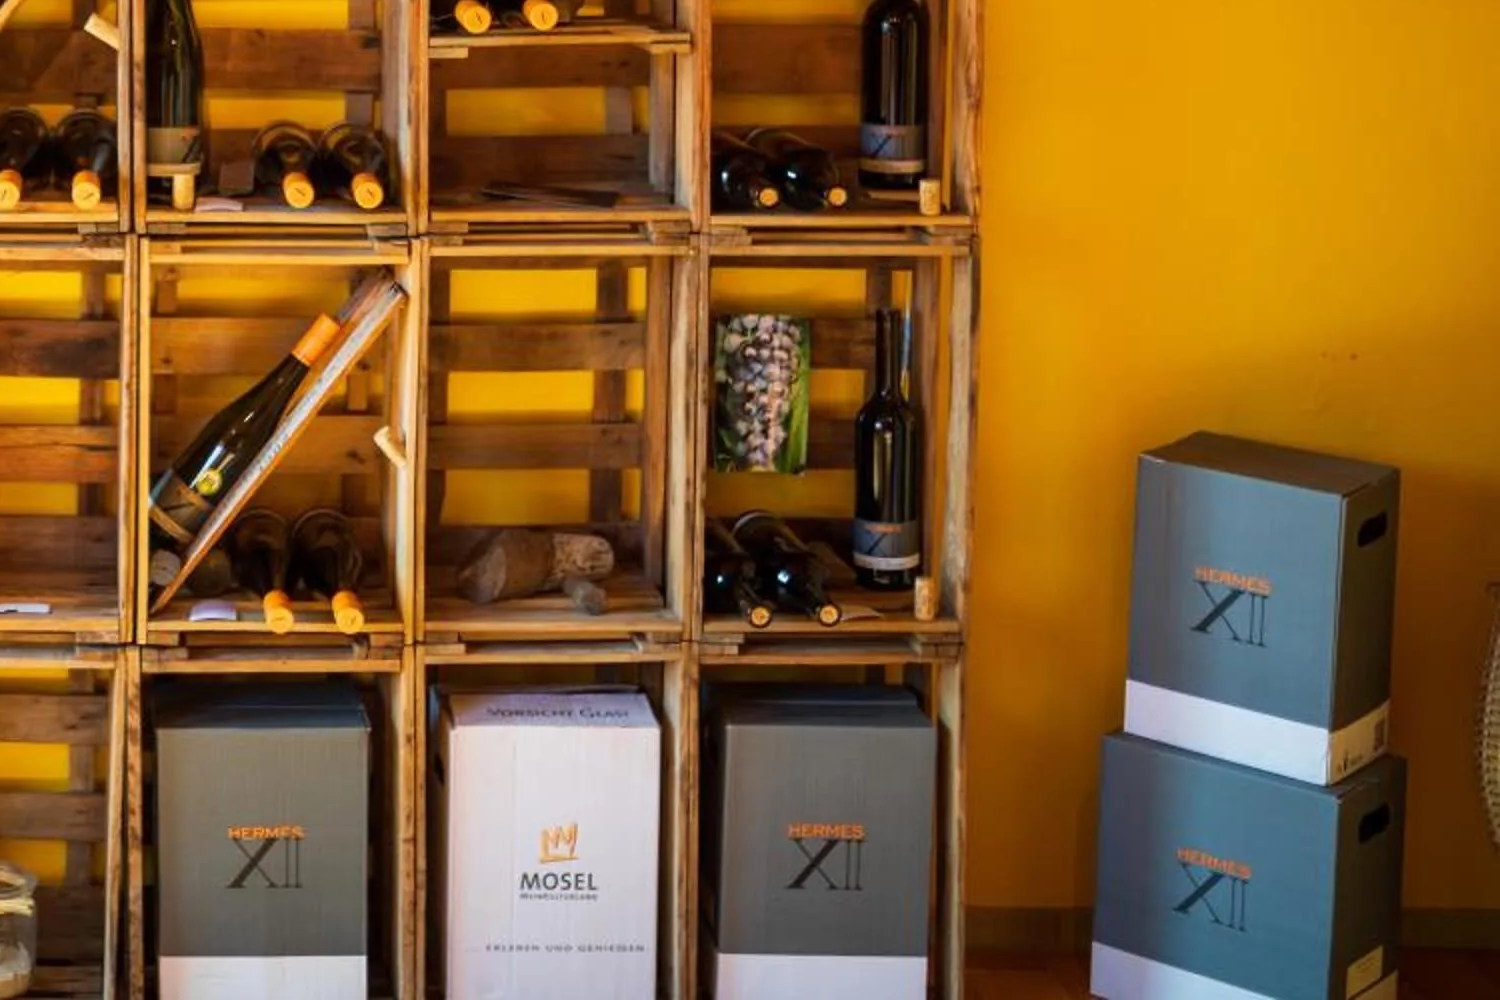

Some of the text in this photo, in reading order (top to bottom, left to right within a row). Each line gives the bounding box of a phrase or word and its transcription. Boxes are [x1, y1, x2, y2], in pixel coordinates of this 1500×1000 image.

[227, 825, 306, 840] HERMES
[787, 823, 866, 840] HERMES
[226, 837, 303, 889] XII
[784, 838, 863, 890] XII
[519, 872, 598, 891] MOSEL
